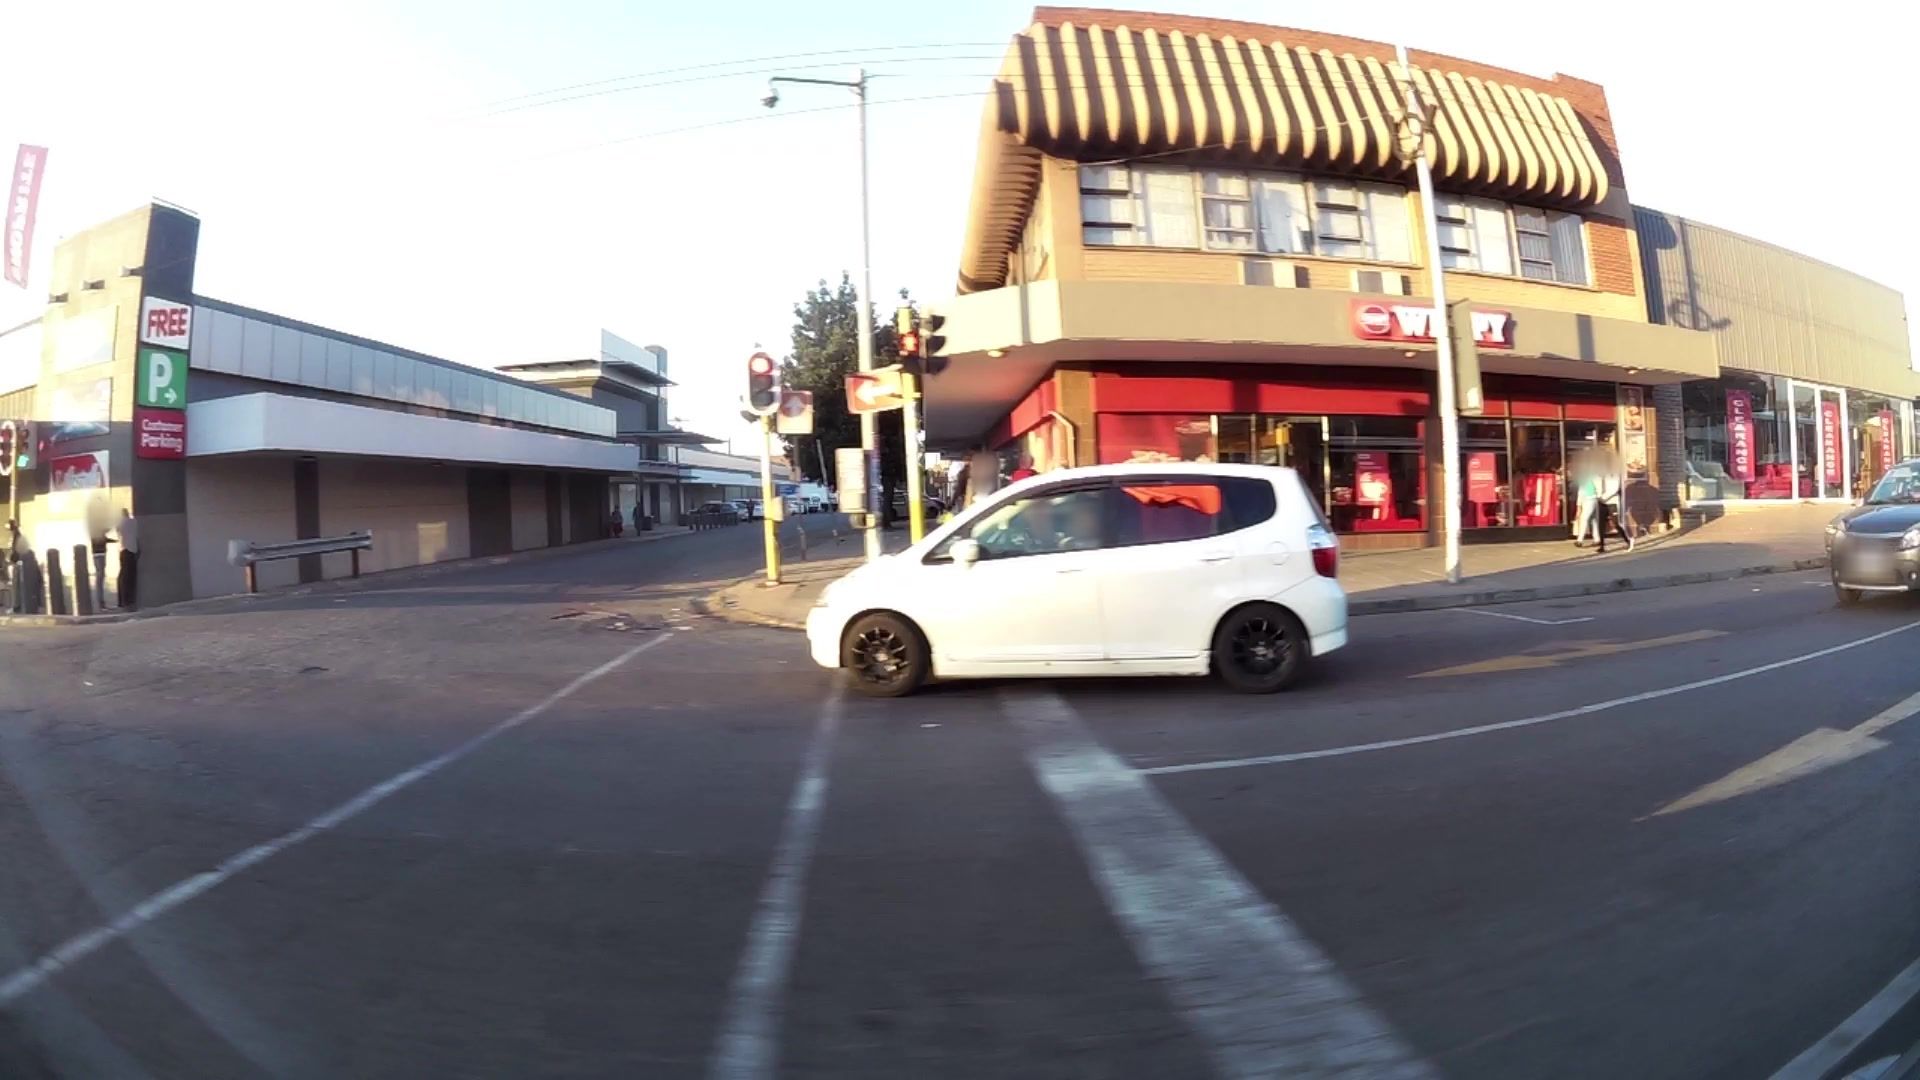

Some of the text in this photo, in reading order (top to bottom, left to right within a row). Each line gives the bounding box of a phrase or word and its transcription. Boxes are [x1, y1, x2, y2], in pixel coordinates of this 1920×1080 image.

[147, 308, 187, 338] FREE
[148, 353, 172, 402] P
[142, 419, 183, 431] Customer
[1733, 400, 1748, 473] CLEARANCE
[141, 432, 183, 452] Parking
